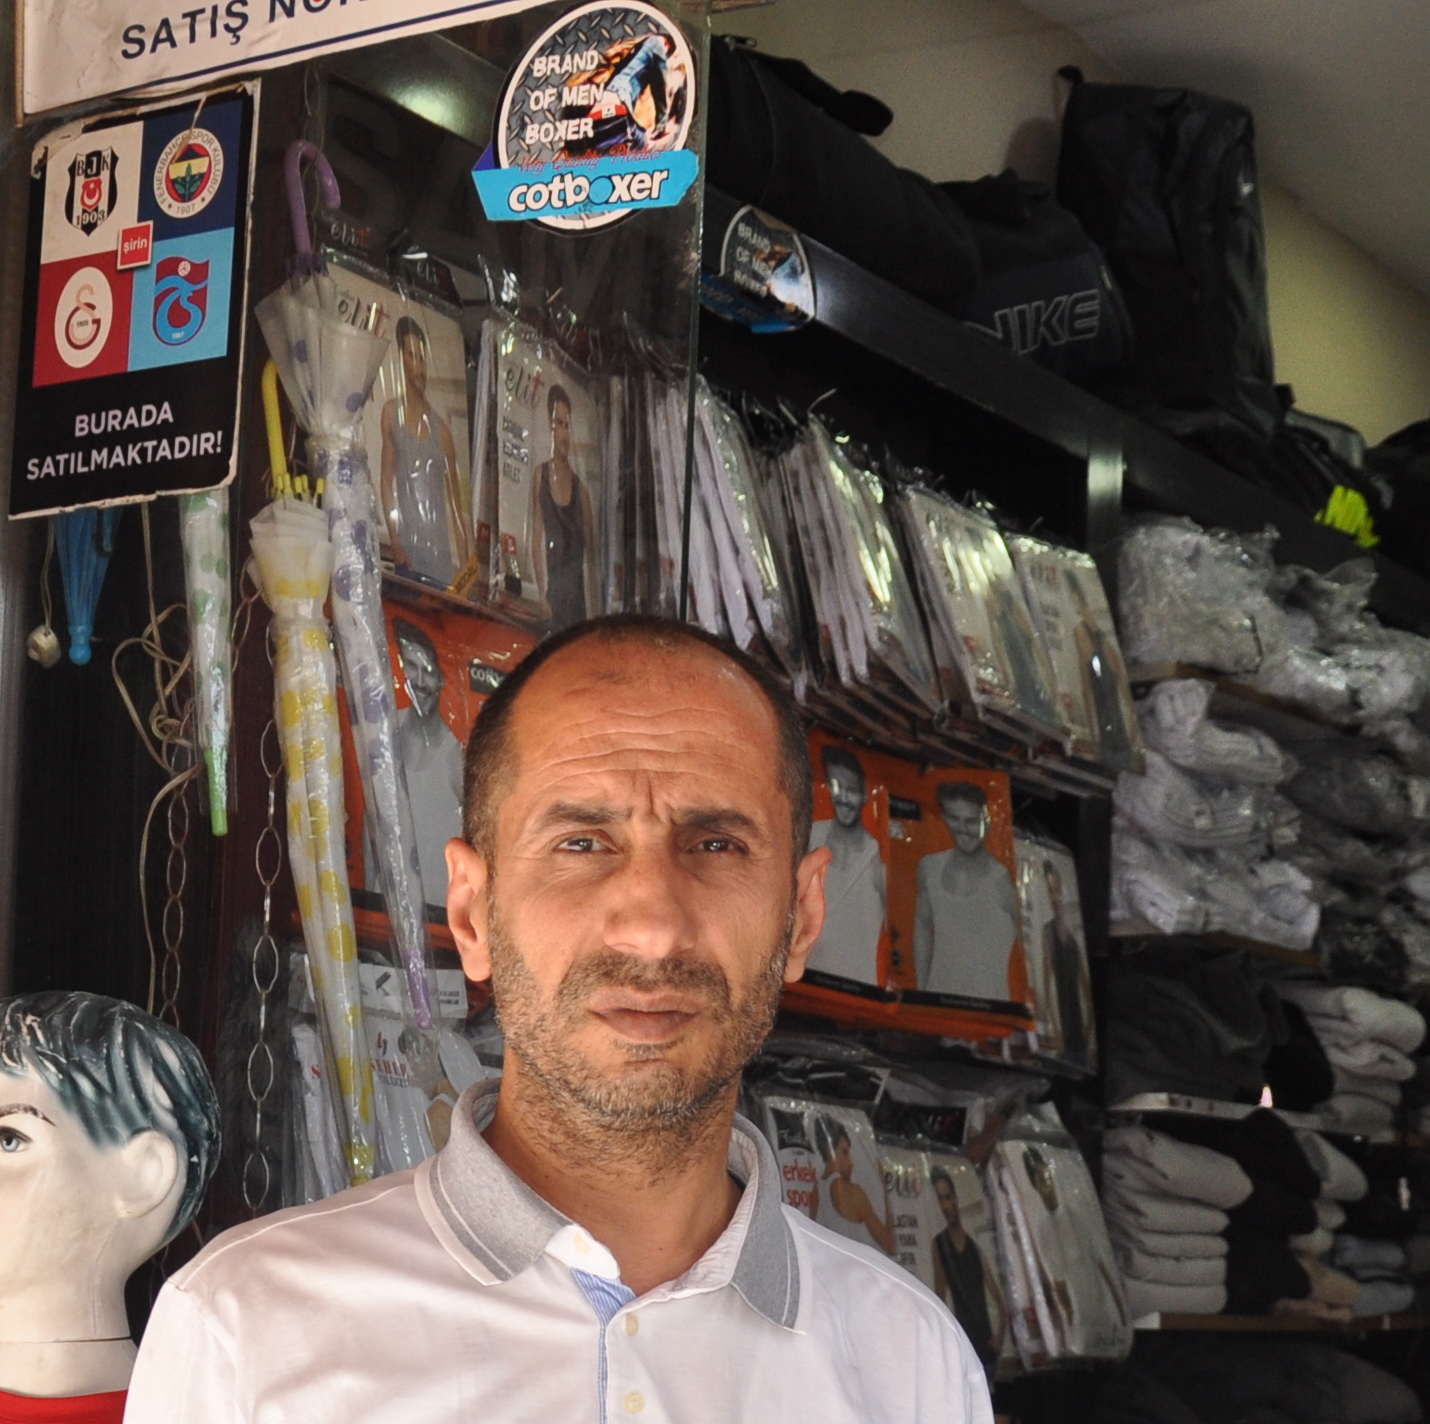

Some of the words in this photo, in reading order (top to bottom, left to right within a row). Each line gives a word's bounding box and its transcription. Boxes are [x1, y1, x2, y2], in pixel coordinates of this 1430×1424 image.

[121, 0, 250, 59] SATIŞ
[532, 50, 599, 78] BRAND
[529, 87, 558, 111] OF
[562, 82, 605, 107] MEN
[525, 117, 595, 145] BOXER
[74, 401, 175, 438] BURADA
[26, 430, 224, 481] SATILMAKTADIR!
